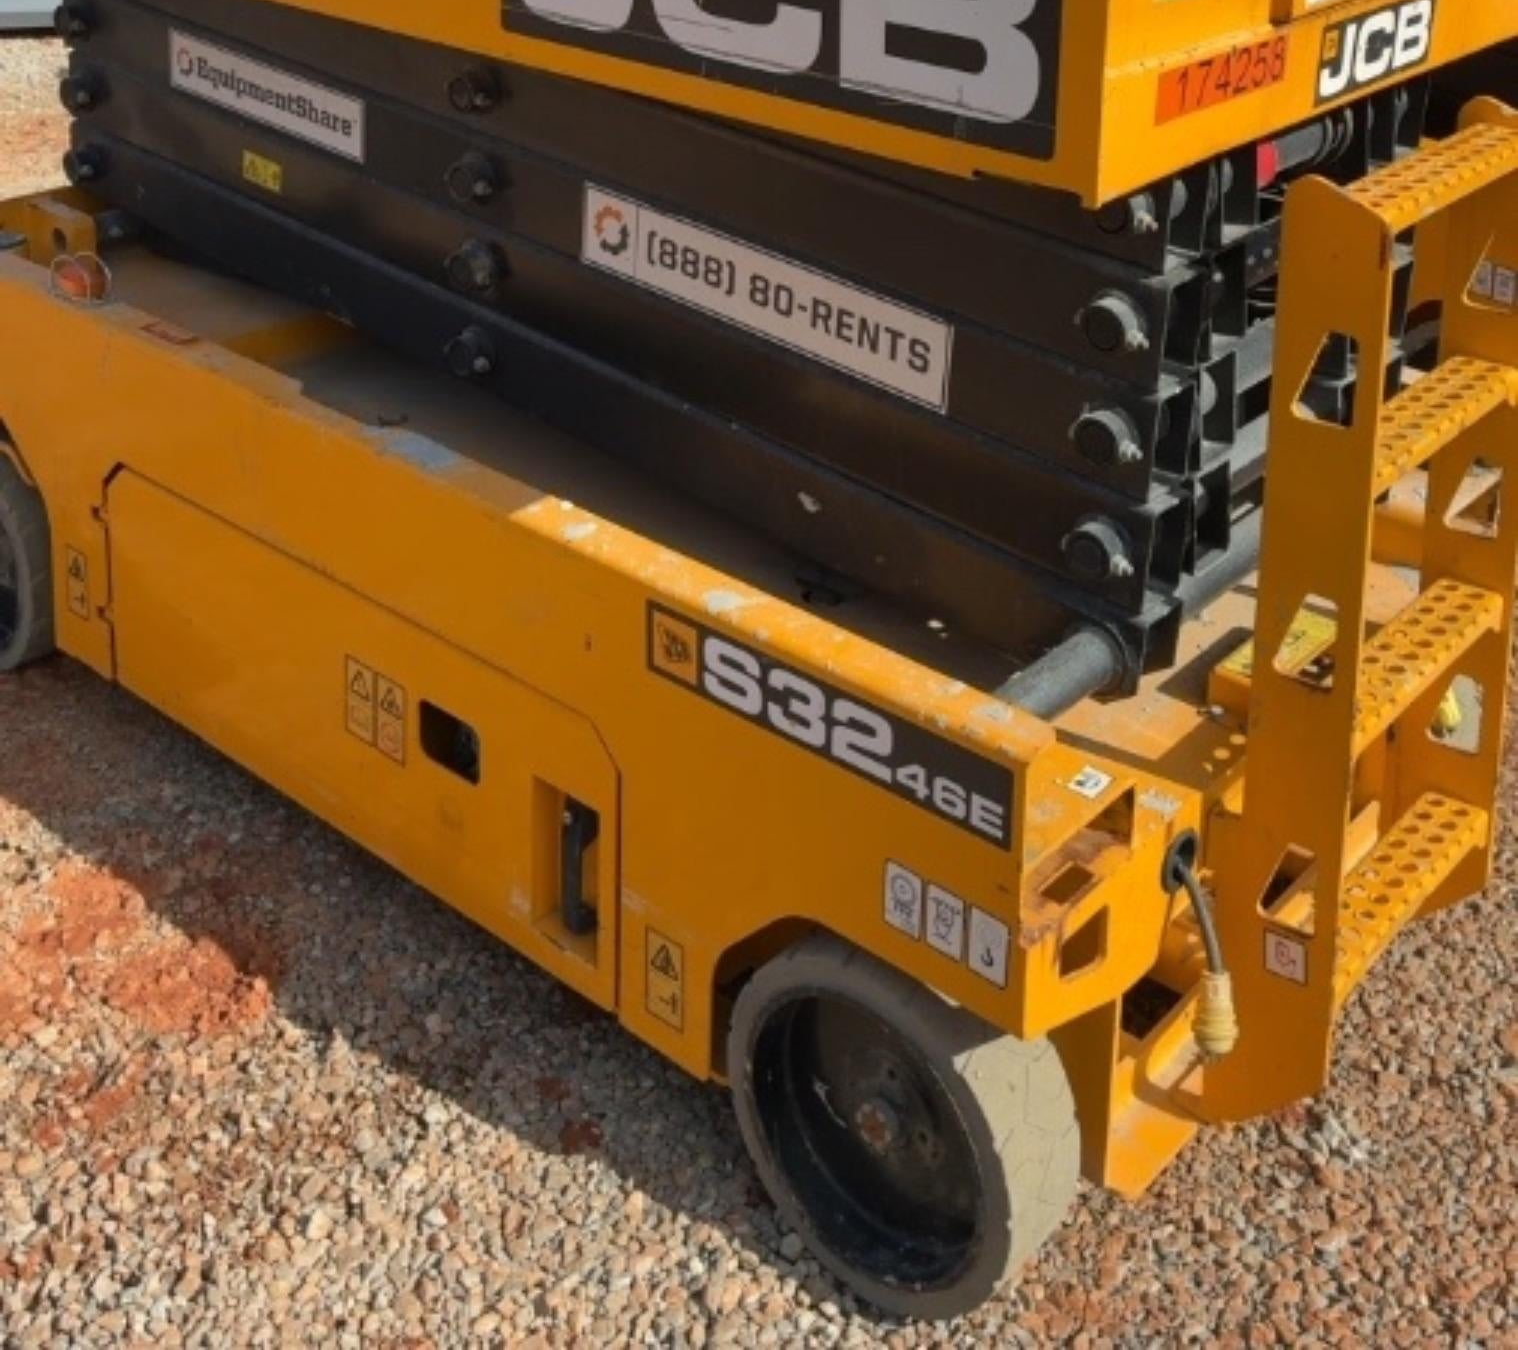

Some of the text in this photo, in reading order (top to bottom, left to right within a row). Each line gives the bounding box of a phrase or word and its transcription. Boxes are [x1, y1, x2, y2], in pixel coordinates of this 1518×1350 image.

[196, 56, 353, 137] EquipmentShare
[1177, 35, 1286, 115] 174258
[646, 229, 932, 375] (888) 80-RENTS
